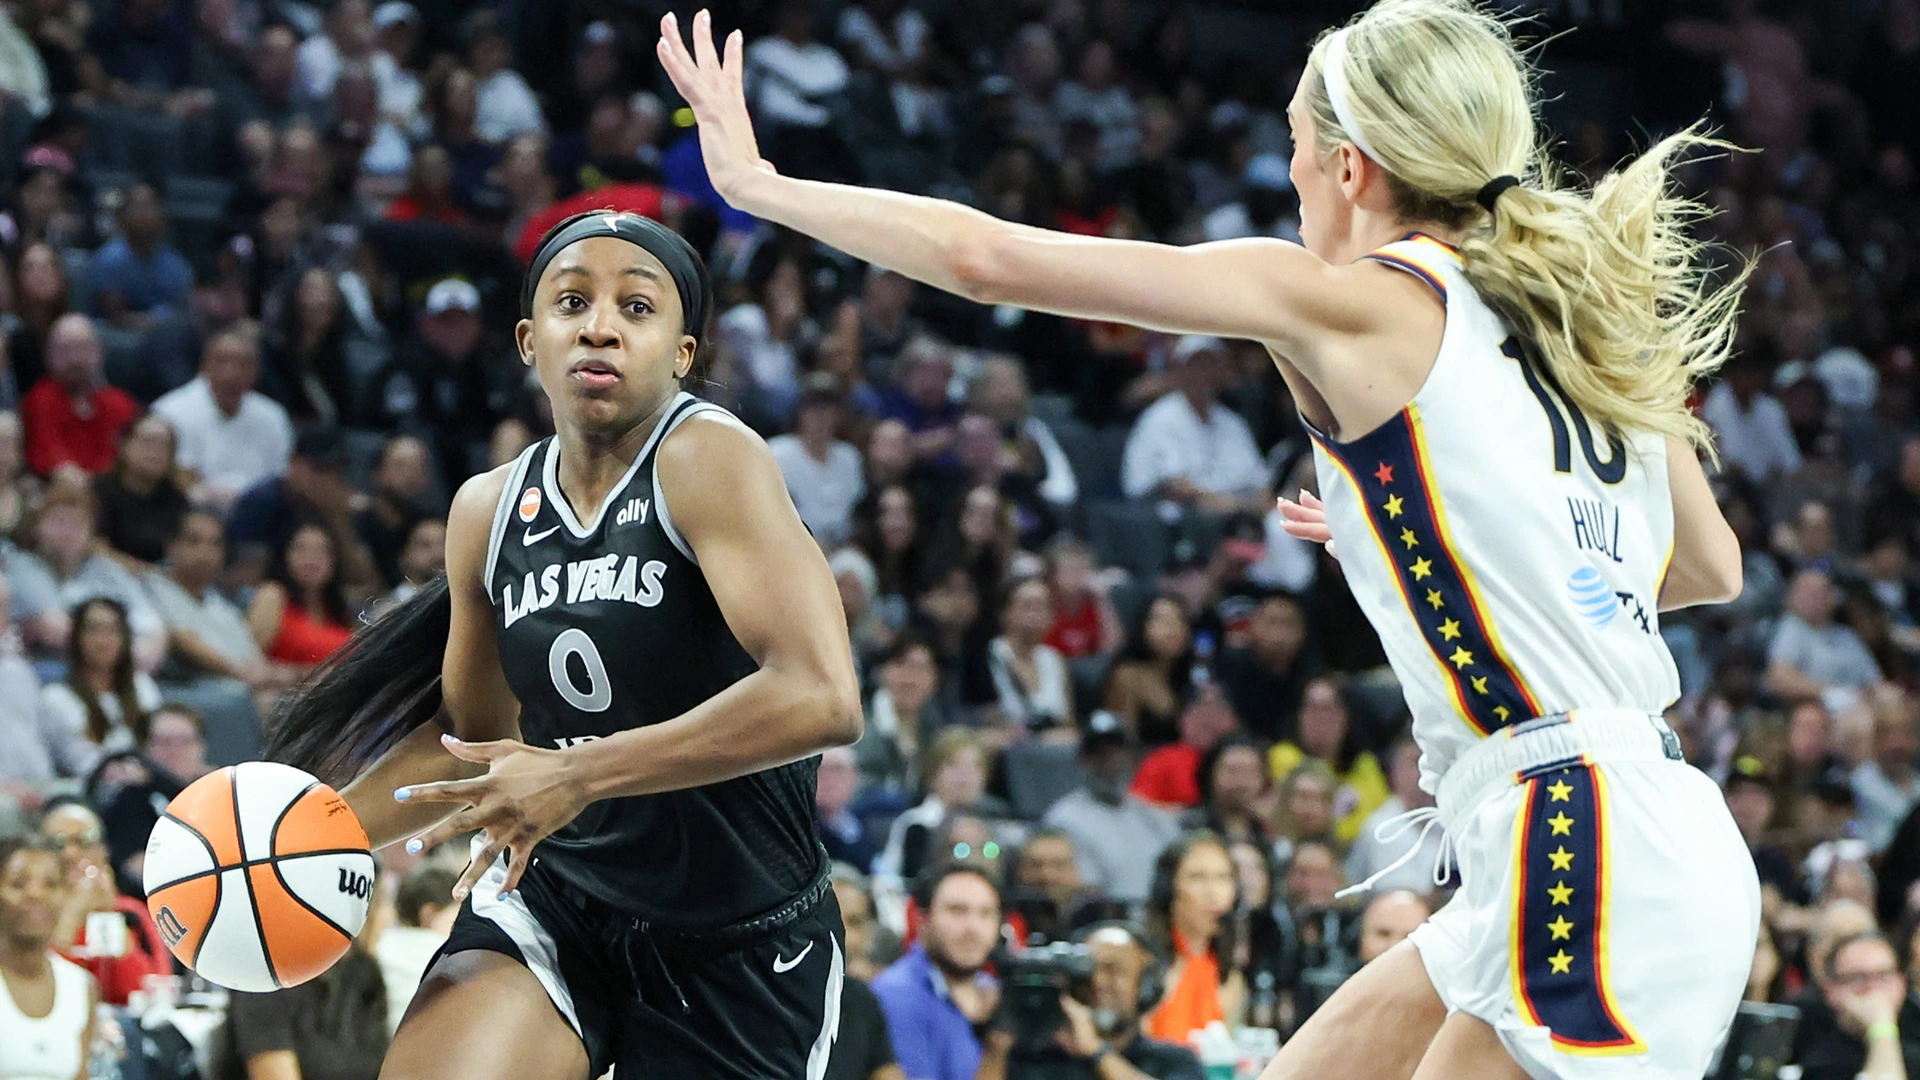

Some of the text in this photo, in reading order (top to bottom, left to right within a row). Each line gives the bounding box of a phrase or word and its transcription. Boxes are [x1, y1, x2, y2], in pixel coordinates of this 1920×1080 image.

[1499, 335, 1627, 485] 10
[616, 498, 649, 526] ally
[1566, 496, 1623, 563] HULL
[503, 553, 668, 629] LAS VEGAS
[548, 627, 612, 713] 0
